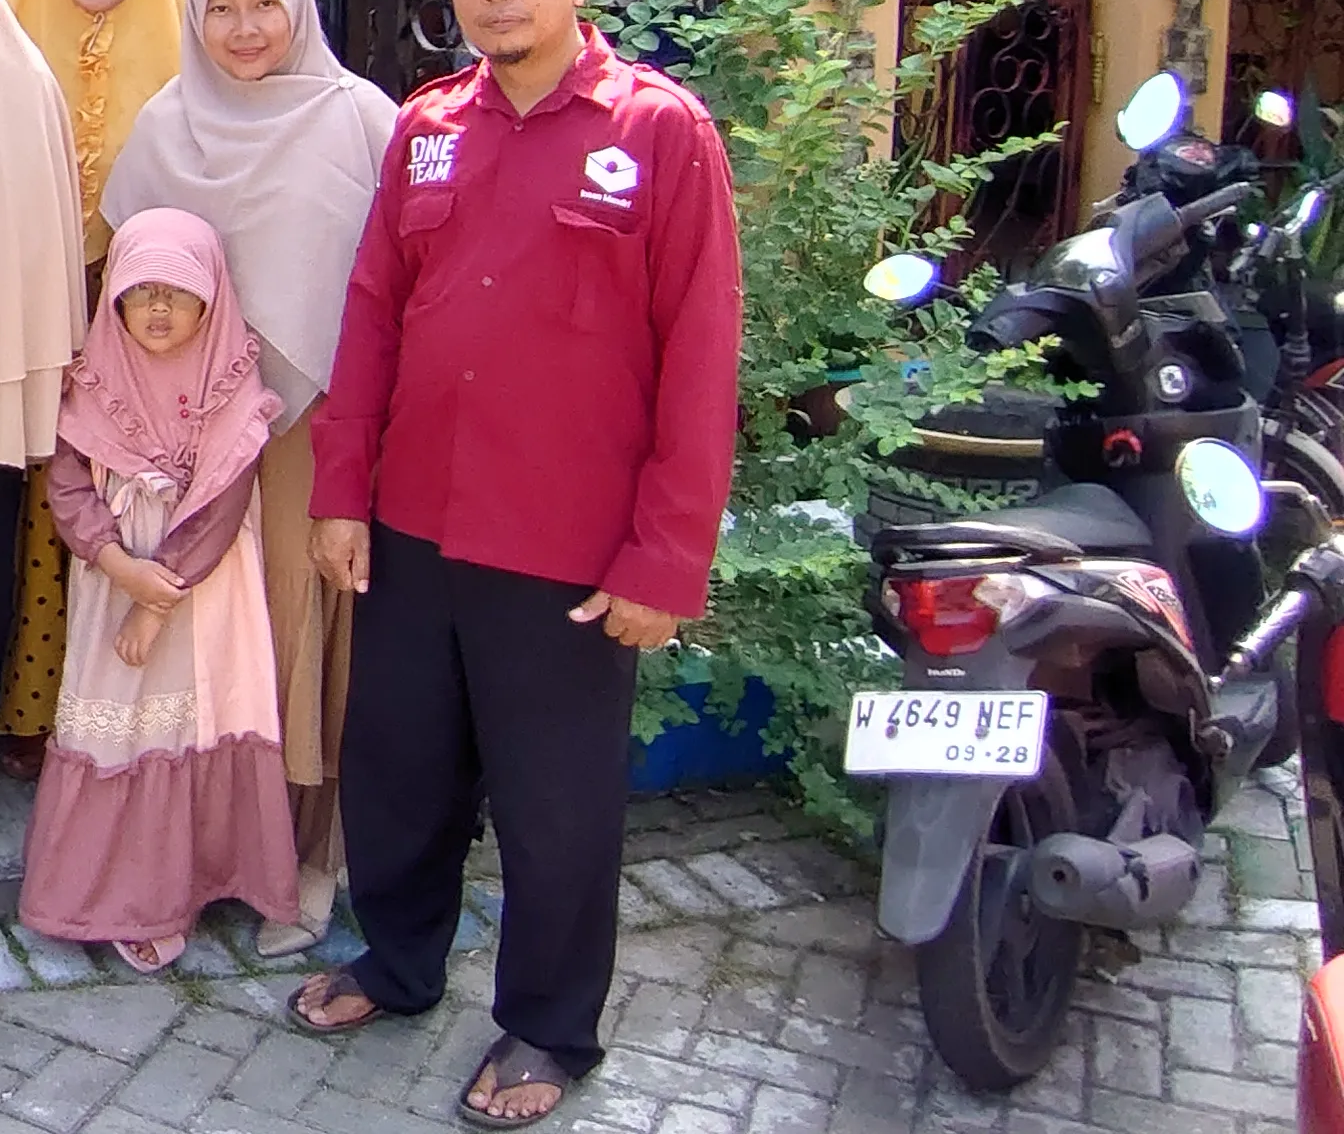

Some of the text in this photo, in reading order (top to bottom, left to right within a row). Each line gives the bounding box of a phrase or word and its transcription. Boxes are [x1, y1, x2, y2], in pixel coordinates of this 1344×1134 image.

[410, 133, 460, 163] ONE
[406, 161, 452, 186] TEAM
[855, 699, 1035, 730] W 4649 NEF
